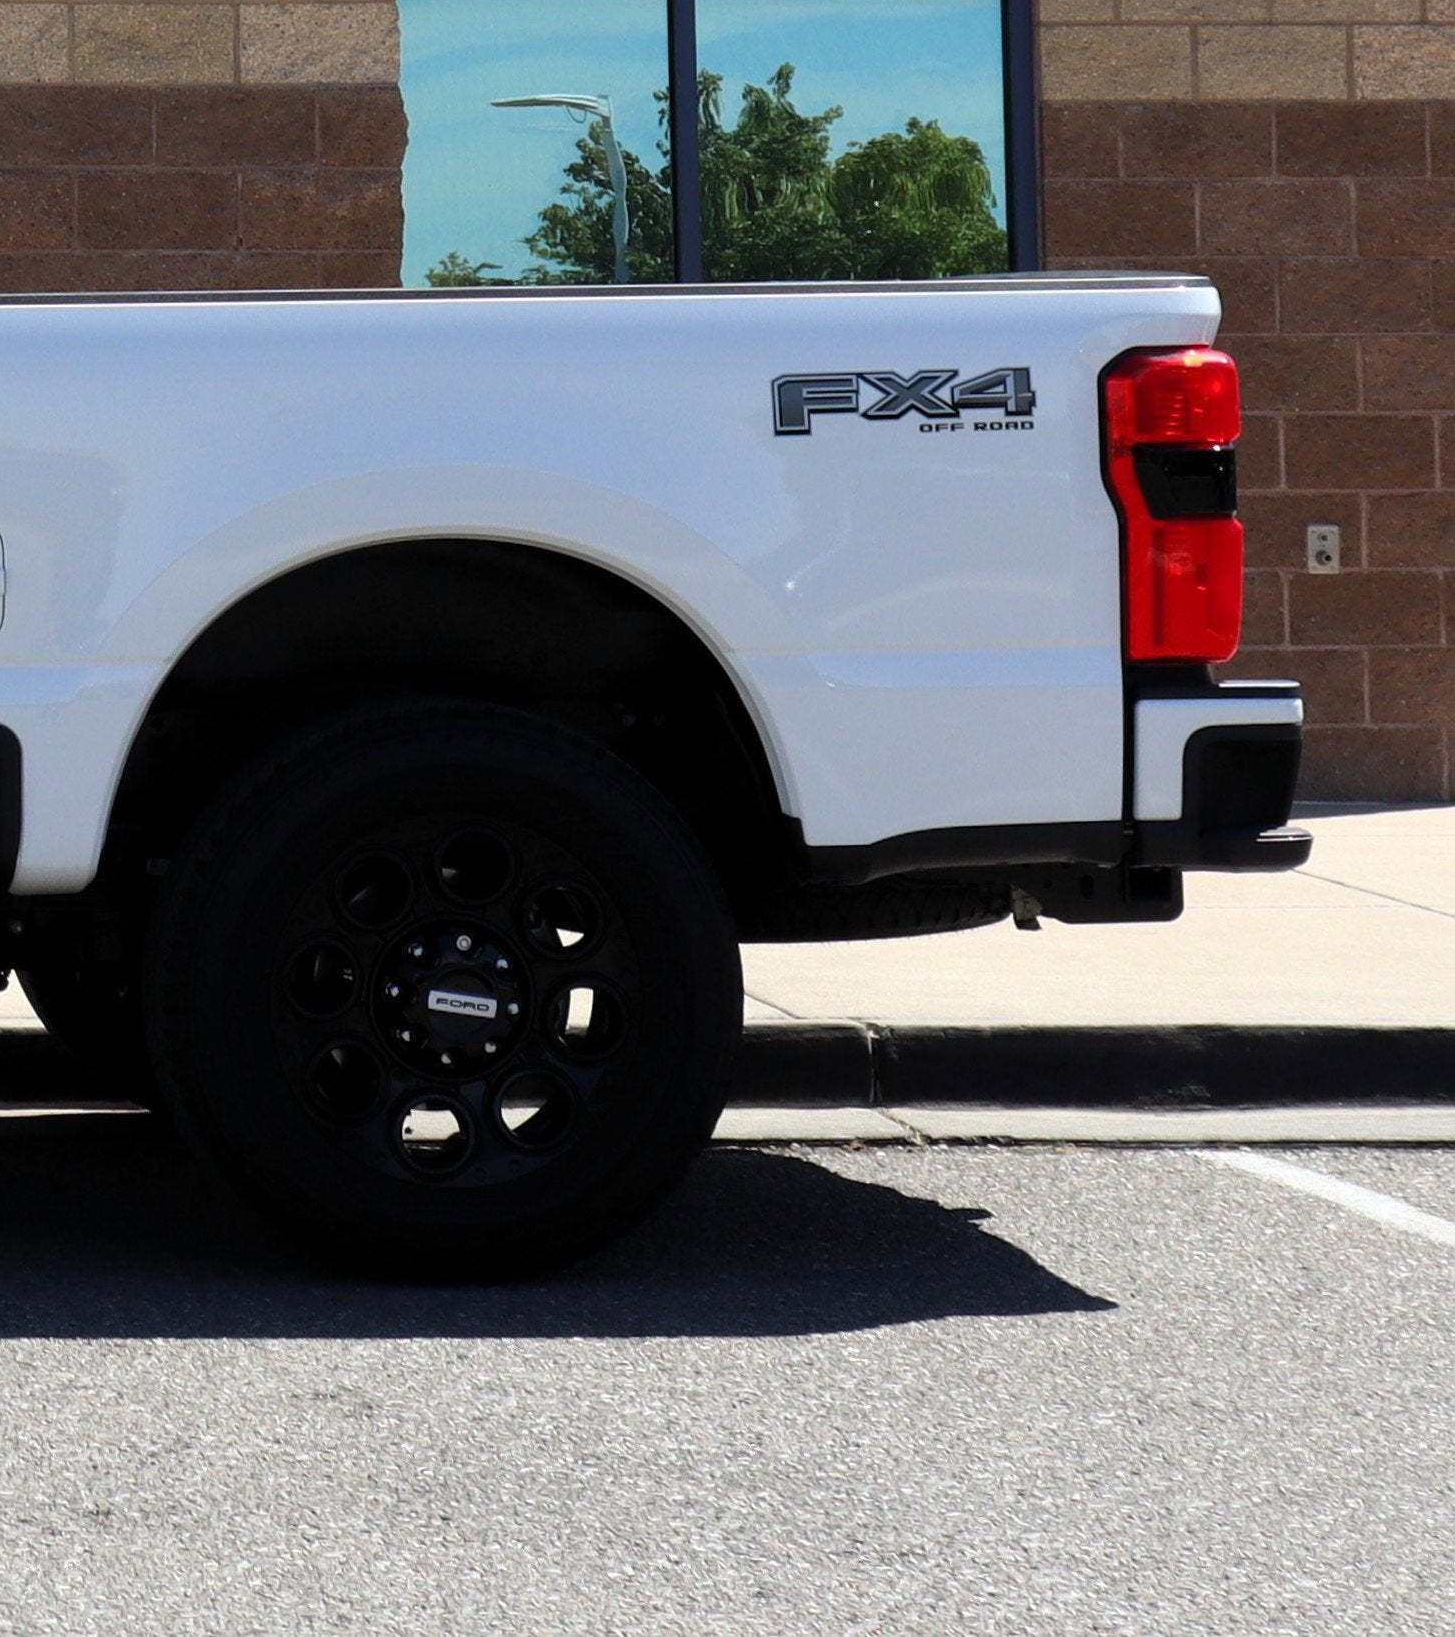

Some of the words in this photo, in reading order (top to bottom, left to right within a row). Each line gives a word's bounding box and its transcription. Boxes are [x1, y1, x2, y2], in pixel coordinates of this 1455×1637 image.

[771, 367, 1036, 437] FX4
[919, 423, 964, 432] OFF
[974, 421, 1034, 431] ROAD
[436, 998, 490, 1012] FORD
